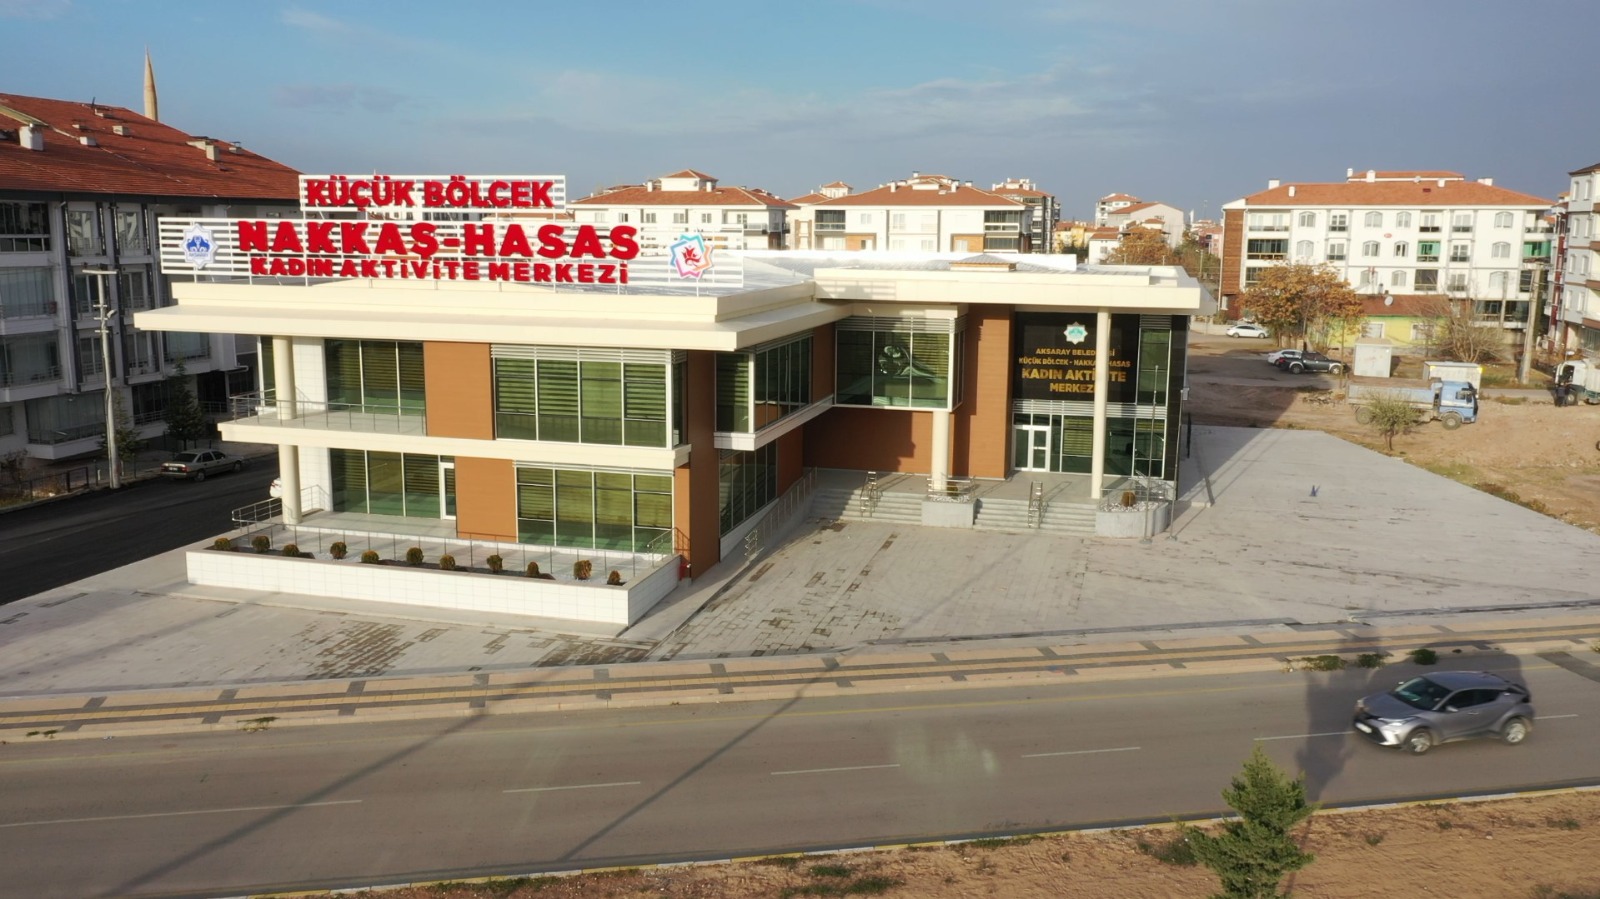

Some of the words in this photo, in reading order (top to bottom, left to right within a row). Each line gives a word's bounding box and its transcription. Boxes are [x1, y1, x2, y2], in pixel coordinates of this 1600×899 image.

[306, 175, 416, 211] KÜÇÜK
[423, 175, 554, 207] BÖLCEK
[237, 220, 640, 260] NAKKAŞ-HASAS
[250, 257, 334, 276] KADIN
[339, 258, 480, 280] AKTİVİTE
[488, 263, 628, 284] MERKEZİ
[1022, 368, 1062, 380] KADIN
